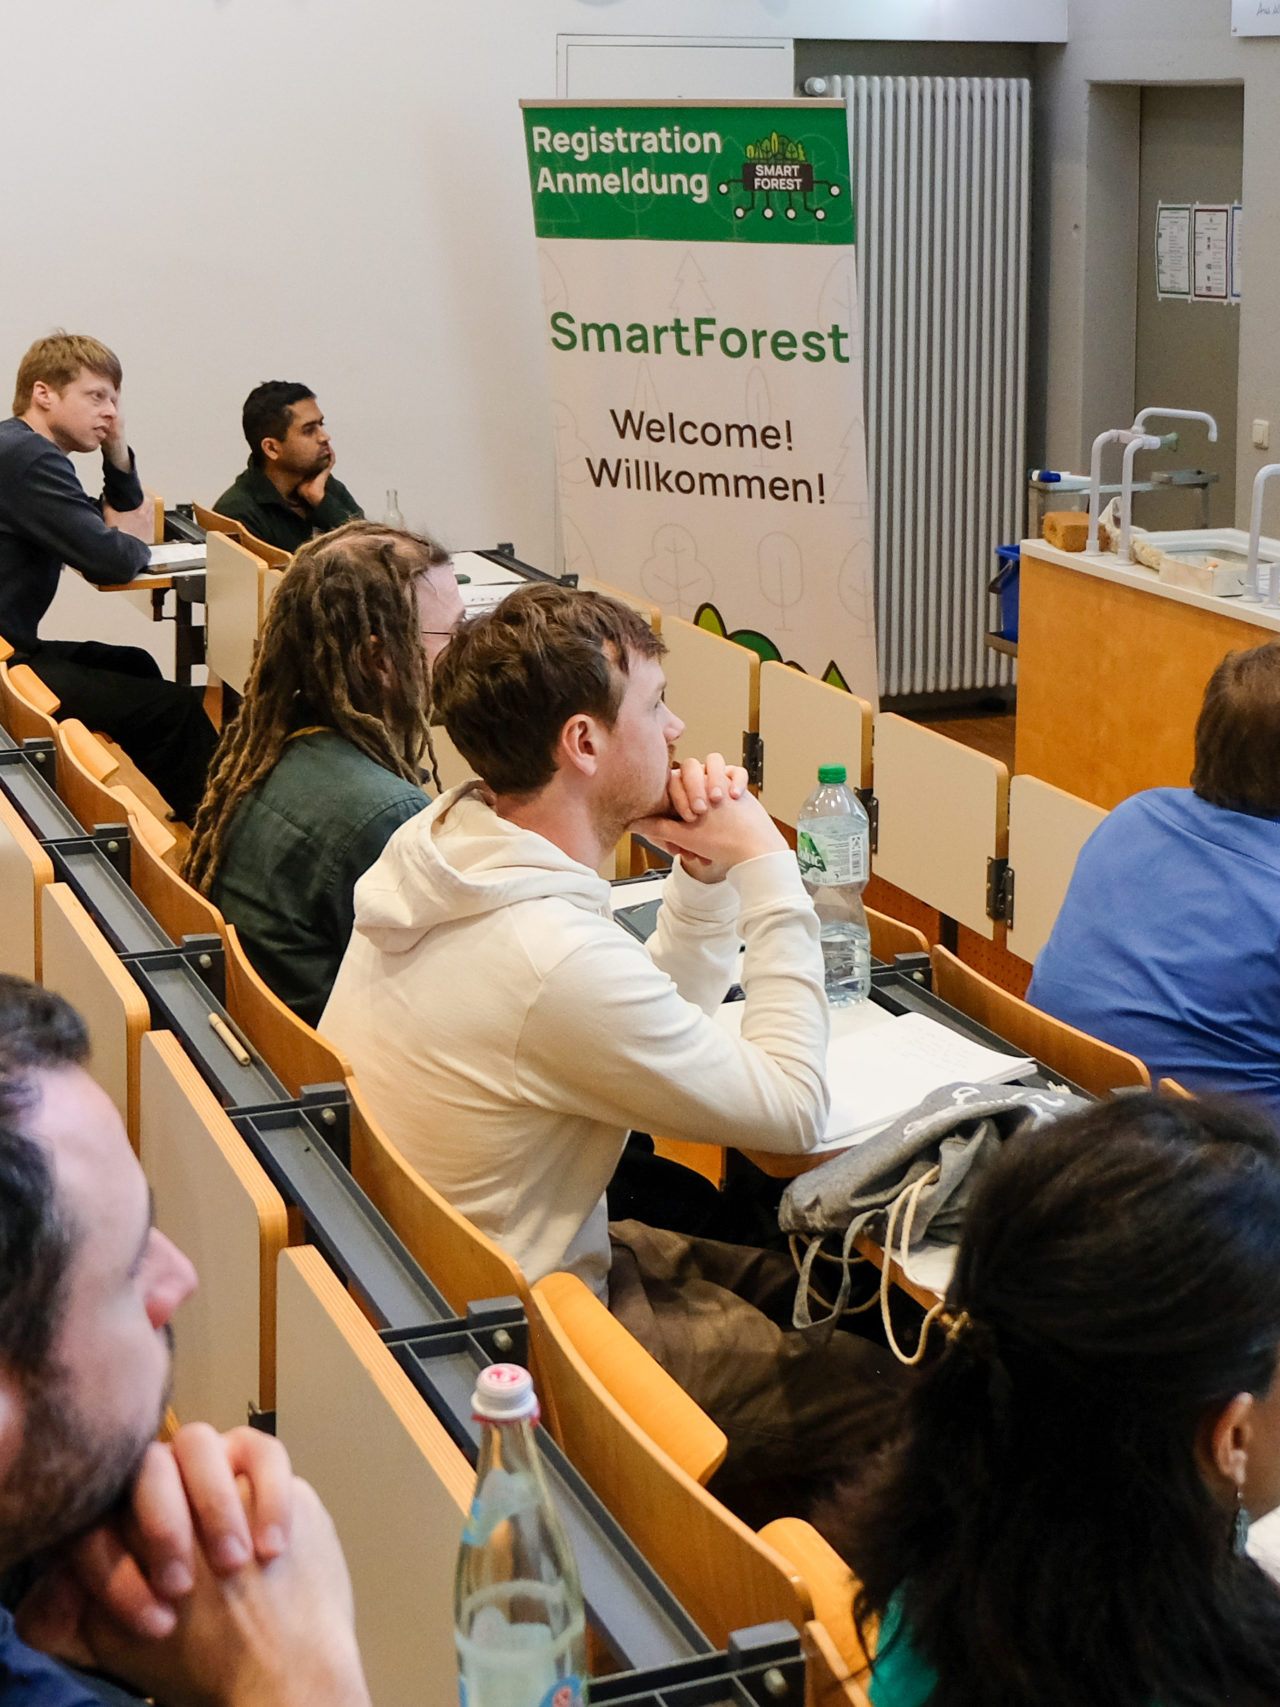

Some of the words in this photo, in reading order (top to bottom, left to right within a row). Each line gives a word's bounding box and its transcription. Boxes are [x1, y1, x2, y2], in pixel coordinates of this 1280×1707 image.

[531, 125, 722, 161] Registration
[537, 166, 709, 204] Anmeldung
[753, 177, 803, 191] FOREST
[755, 164, 800, 177] SMART
[549, 311, 851, 364] SmartForest
[609, 408, 794, 451] Welcome!
[585, 456, 826, 505] Willkommen!
